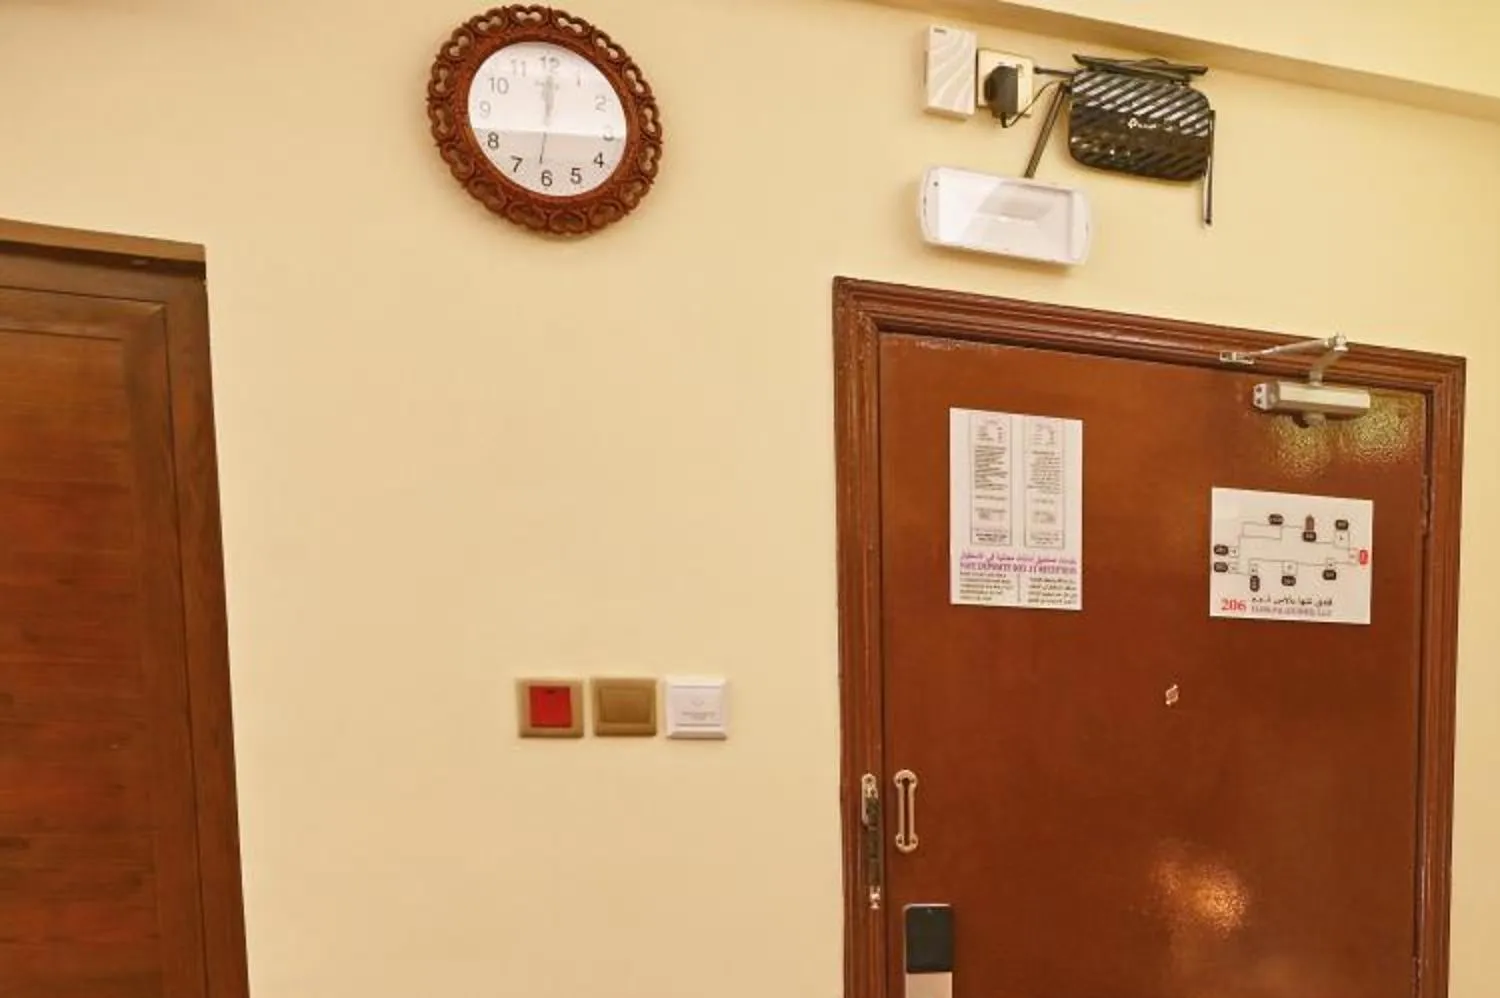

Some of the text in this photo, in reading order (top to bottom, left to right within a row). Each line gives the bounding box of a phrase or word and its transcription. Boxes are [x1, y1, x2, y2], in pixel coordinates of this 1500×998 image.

[539, 56, 560, 73] 12
[489, 77, 509, 95] 10
[479, 100, 491, 119] 9
[595, 95, 608, 112] 2
[487, 131, 500, 150] 8
[510, 155, 523, 173] 7
[593, 152, 606, 168] 4
[541, 170, 553, 187] 6
[570, 167, 583, 184] 5
[1221, 598, 1247, 611] 206
